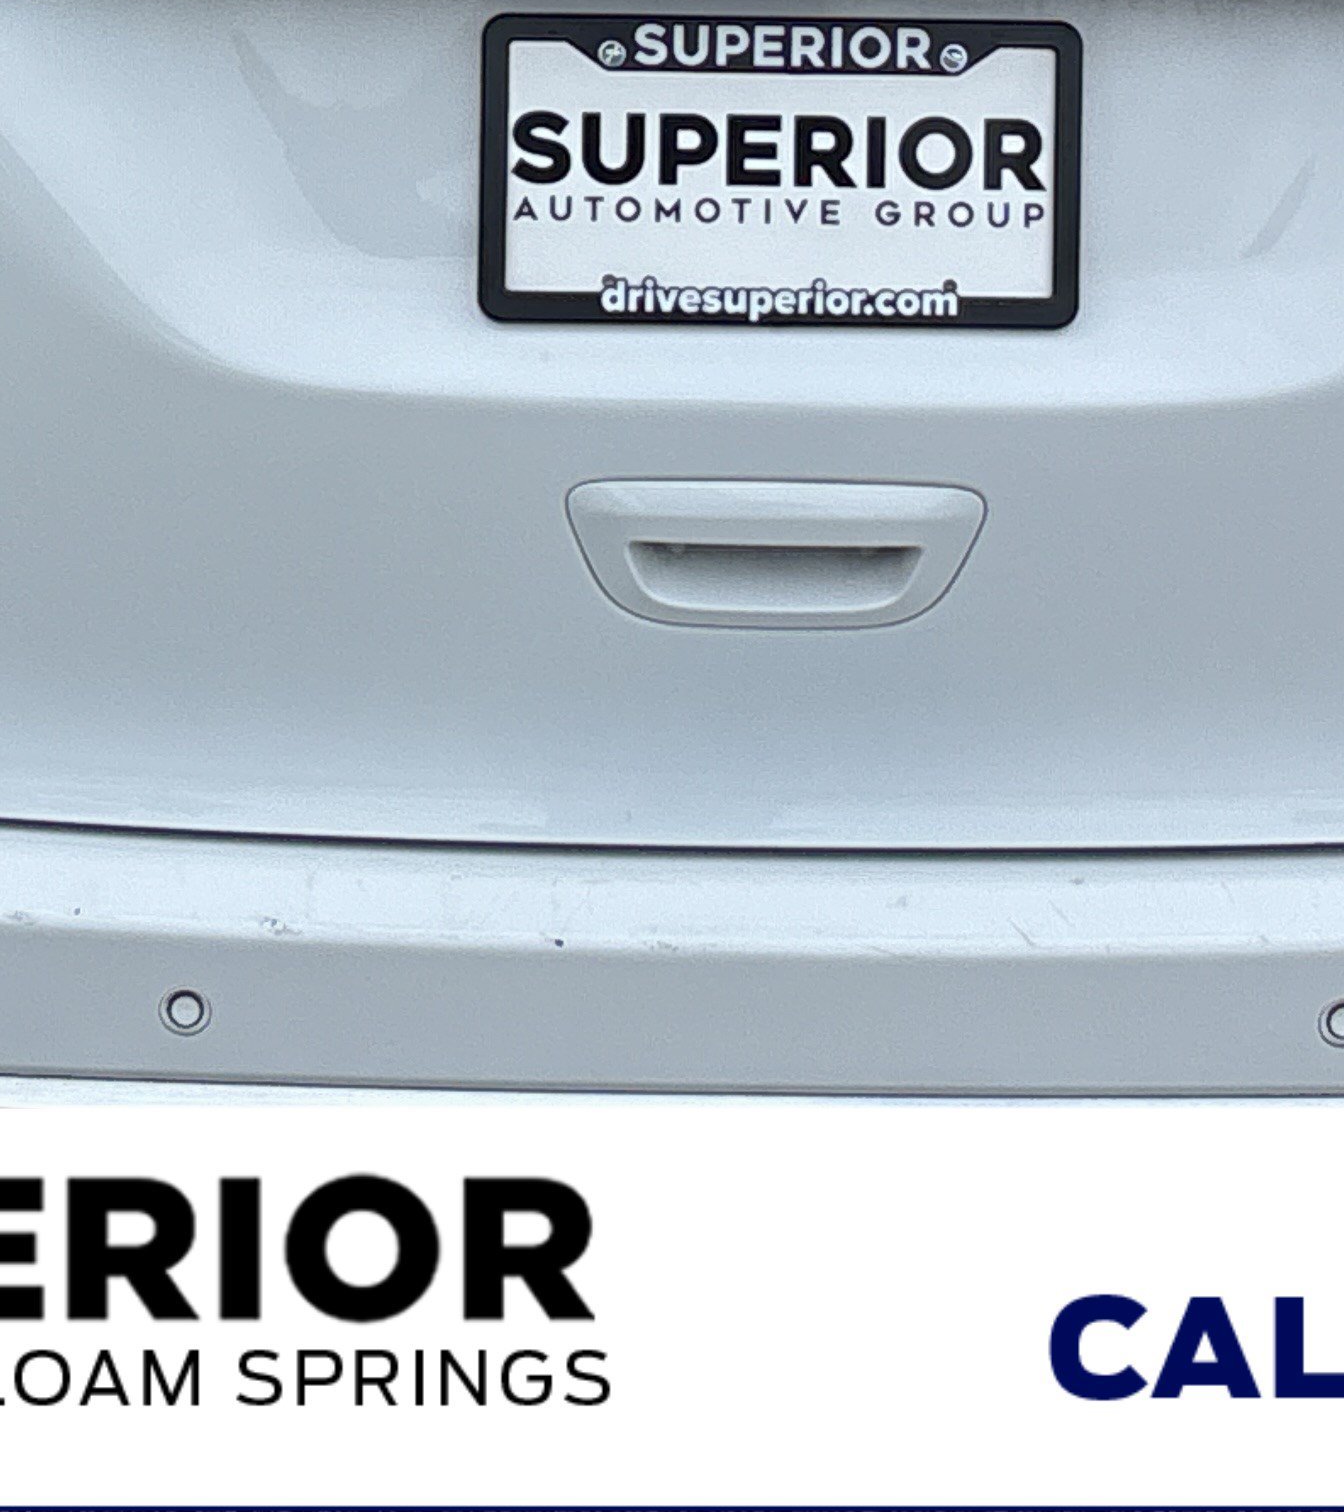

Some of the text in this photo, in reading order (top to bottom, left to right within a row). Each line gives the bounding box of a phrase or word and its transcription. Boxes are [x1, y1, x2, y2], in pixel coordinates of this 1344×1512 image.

[633, 23, 932, 70] SUPERIOR
[511, 111, 1046, 192] SUPERIOR
[513, 196, 1044, 229] AUTOMOTIVE GROUP
[600, 276, 958, 324] drivesuperior.com
